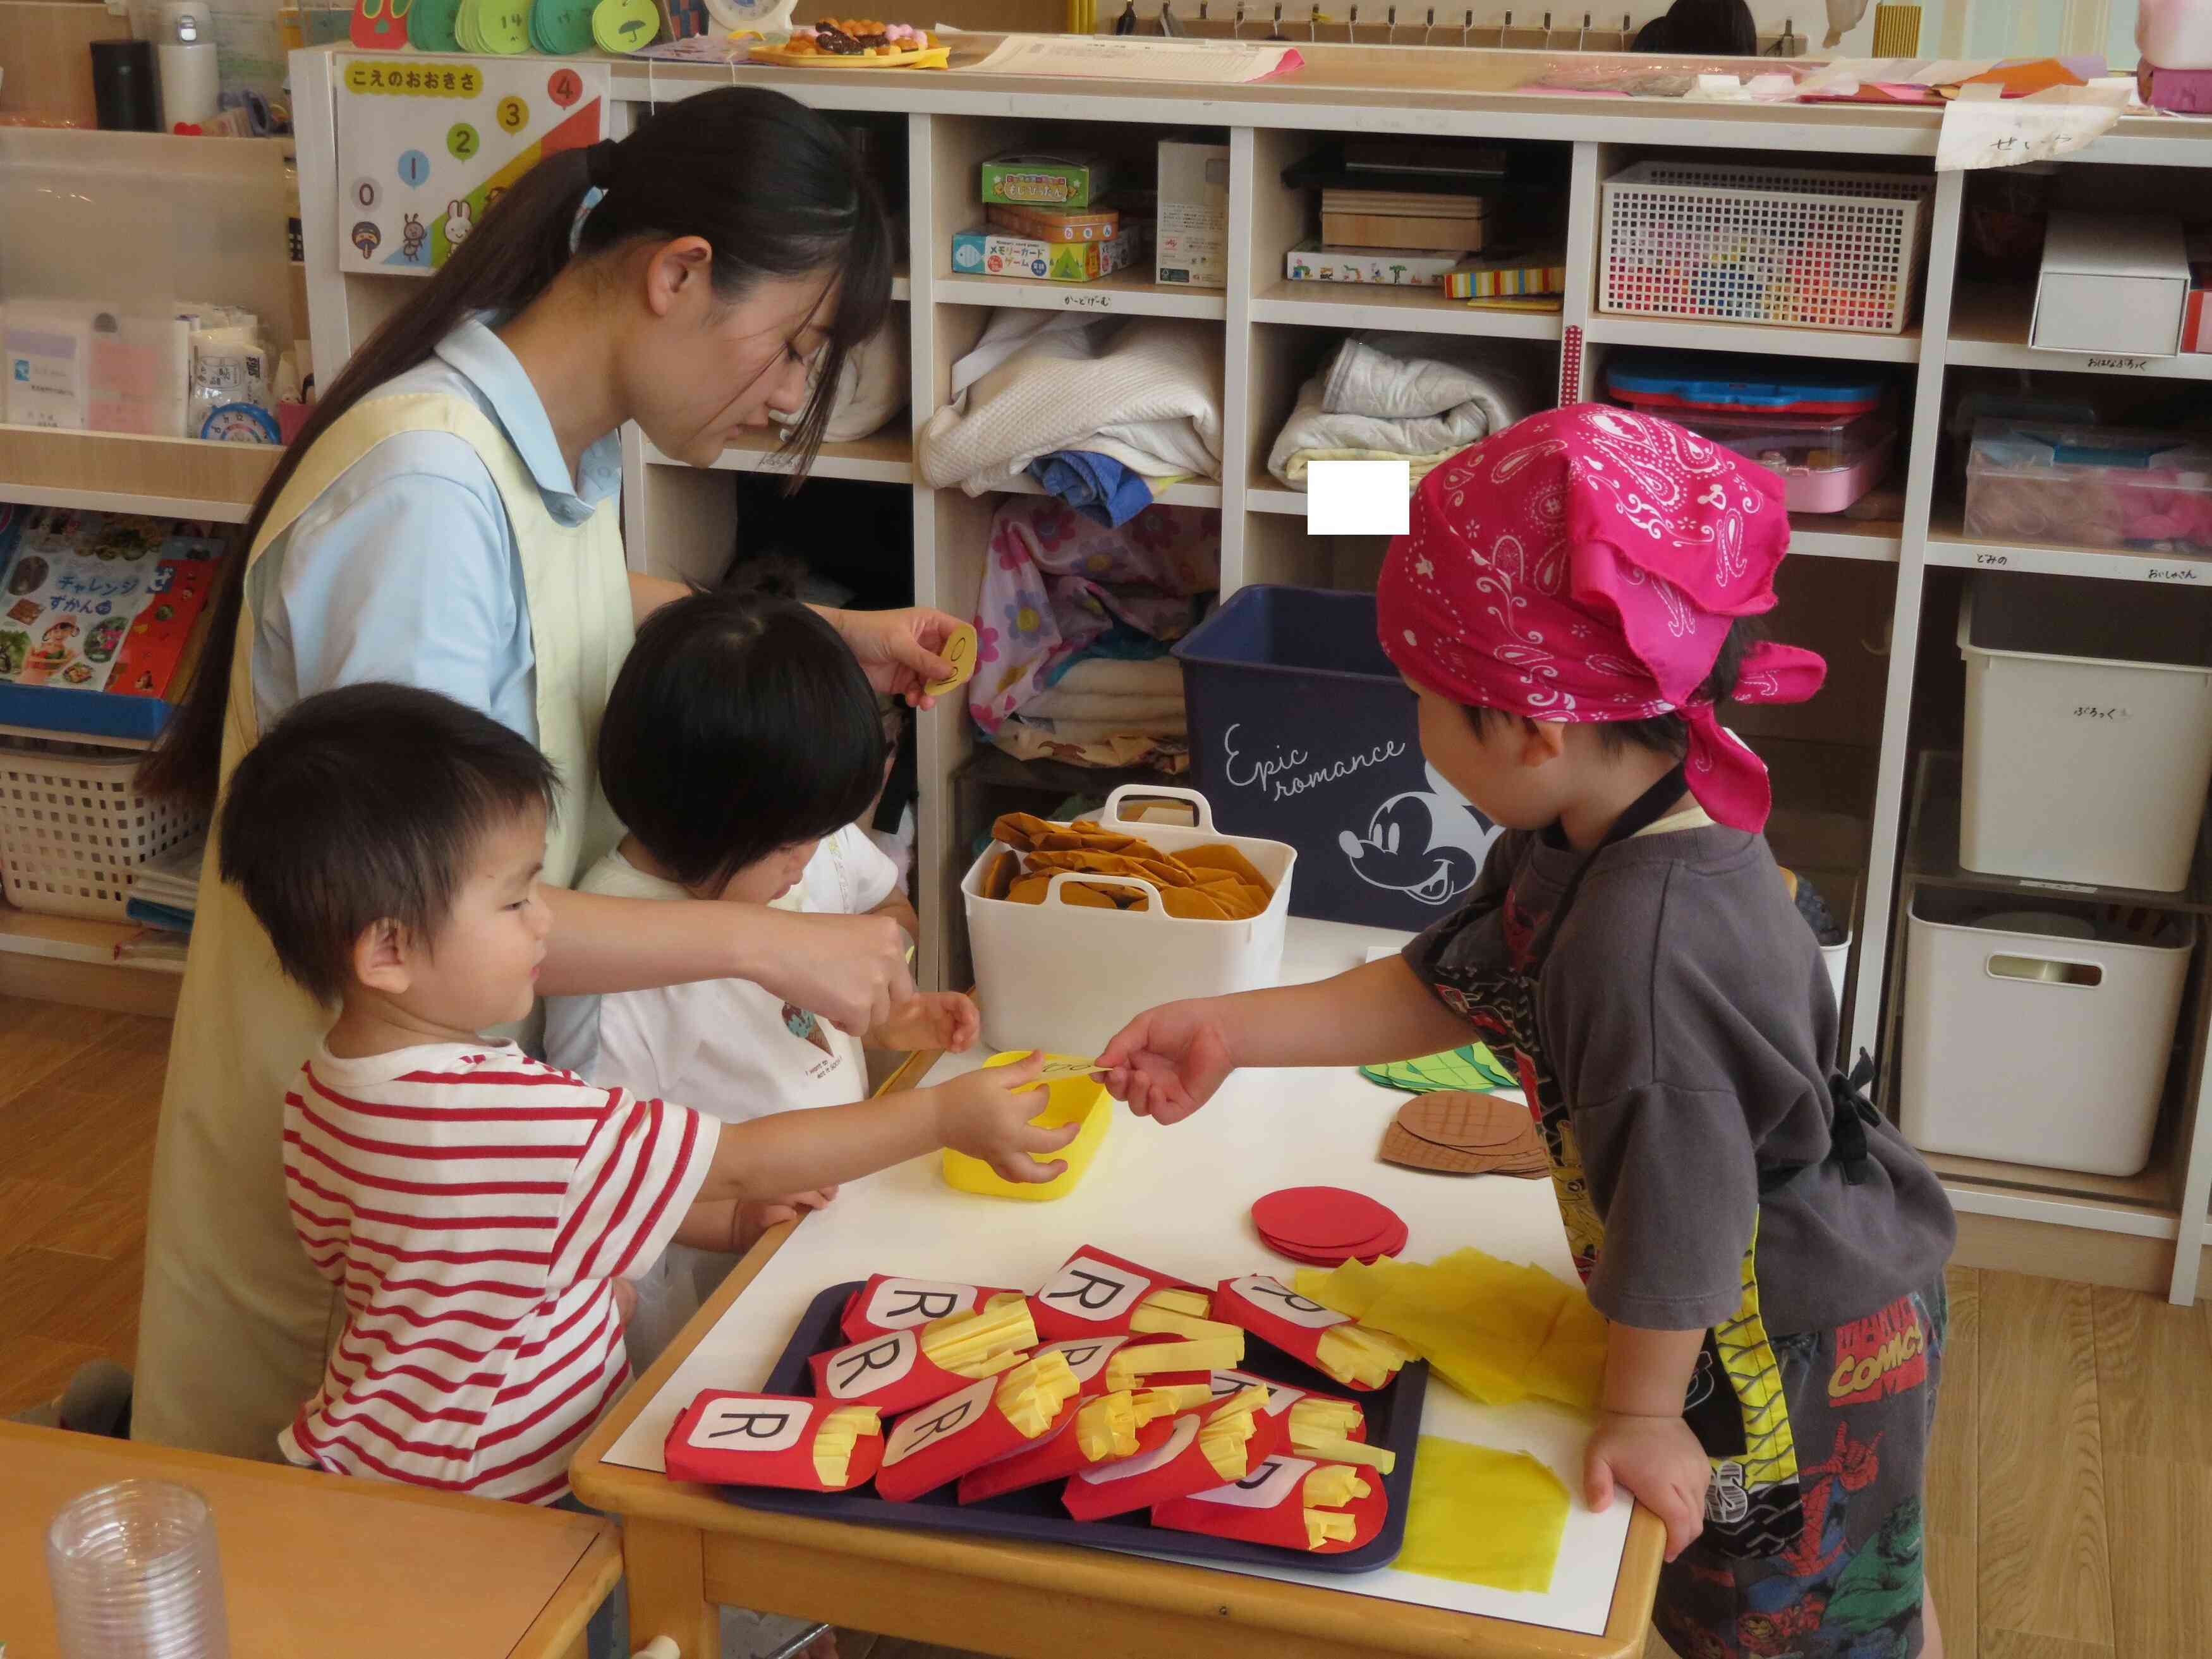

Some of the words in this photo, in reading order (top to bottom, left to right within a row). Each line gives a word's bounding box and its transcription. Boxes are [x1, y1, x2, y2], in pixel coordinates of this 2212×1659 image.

[352, 70, 475, 92] こえのおおきさ
[556, 78, 574, 99] 4
[505, 102, 521, 126] 3
[455, 130, 471, 154] 2
[410, 157, 416, 180] 1
[358, 183, 375, 206] 0
[1976, 553, 2008, 566] どみの
[2148, 569, 2197, 580] おいしゃさん
[1224, 723, 1308, 791] Epic
[1273, 740, 1406, 802] romance
[1047, 1269, 1126, 1310] R
[886, 1289, 957, 1319] R
[836, 1338, 901, 1389] R
[708, 1412, 790, 1440] R
[903, 1399, 972, 1454] R
